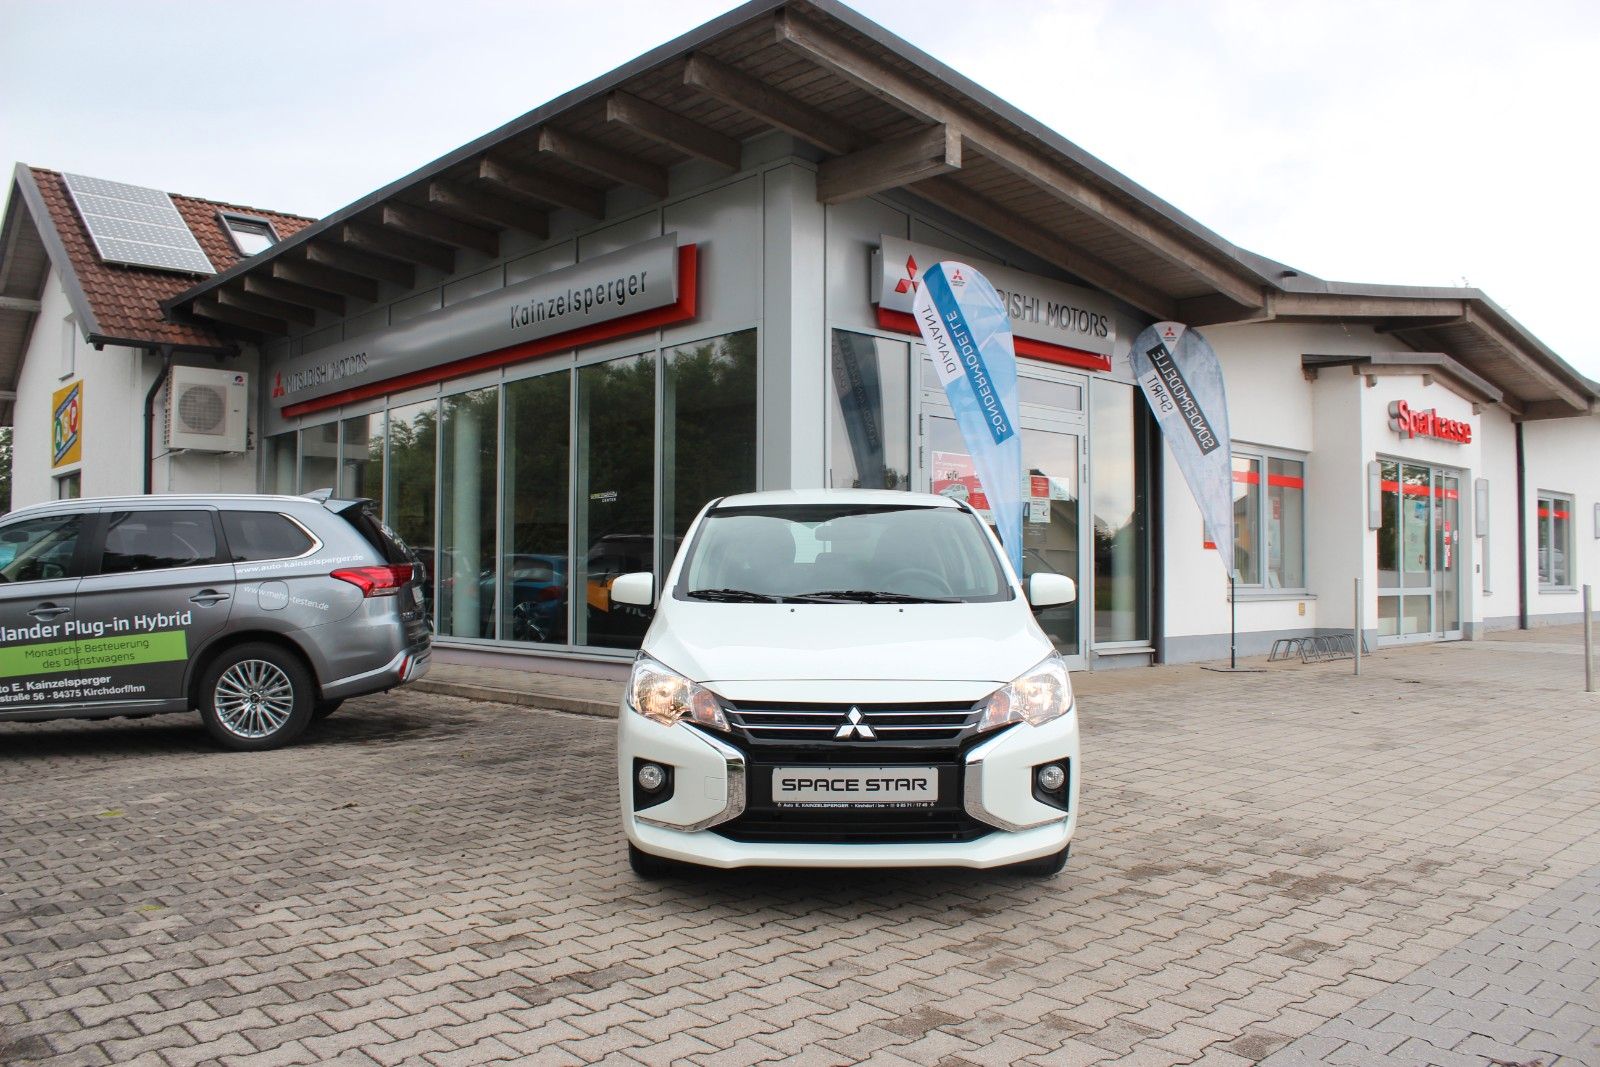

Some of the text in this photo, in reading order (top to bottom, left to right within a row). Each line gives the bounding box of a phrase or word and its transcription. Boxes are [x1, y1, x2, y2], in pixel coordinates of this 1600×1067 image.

[510, 271, 647, 330] Kainzelsperger
[1046, 301, 1110, 338] MOTORS
[332, 352, 368, 380] MOTORS
[1395, 400, 1472, 444] Sparkasse
[64, 615, 130, 636] Plug-in
[134, 610, 192, 632] Hybrid
[25, 638, 150, 659] Monatliche Besteuerung
[42, 652, 136, 669] des Dienstwagens
[12, 683, 24, 692] E.
[26, 675, 112, 690] Kainzelsperger
[33, 691, 45, 701] 56
[53, 690, 82, 700] 84375
[83, 684, 146, 697] Kirchdorf/Inn
[781, 778, 928, 792] SPACE STAR
